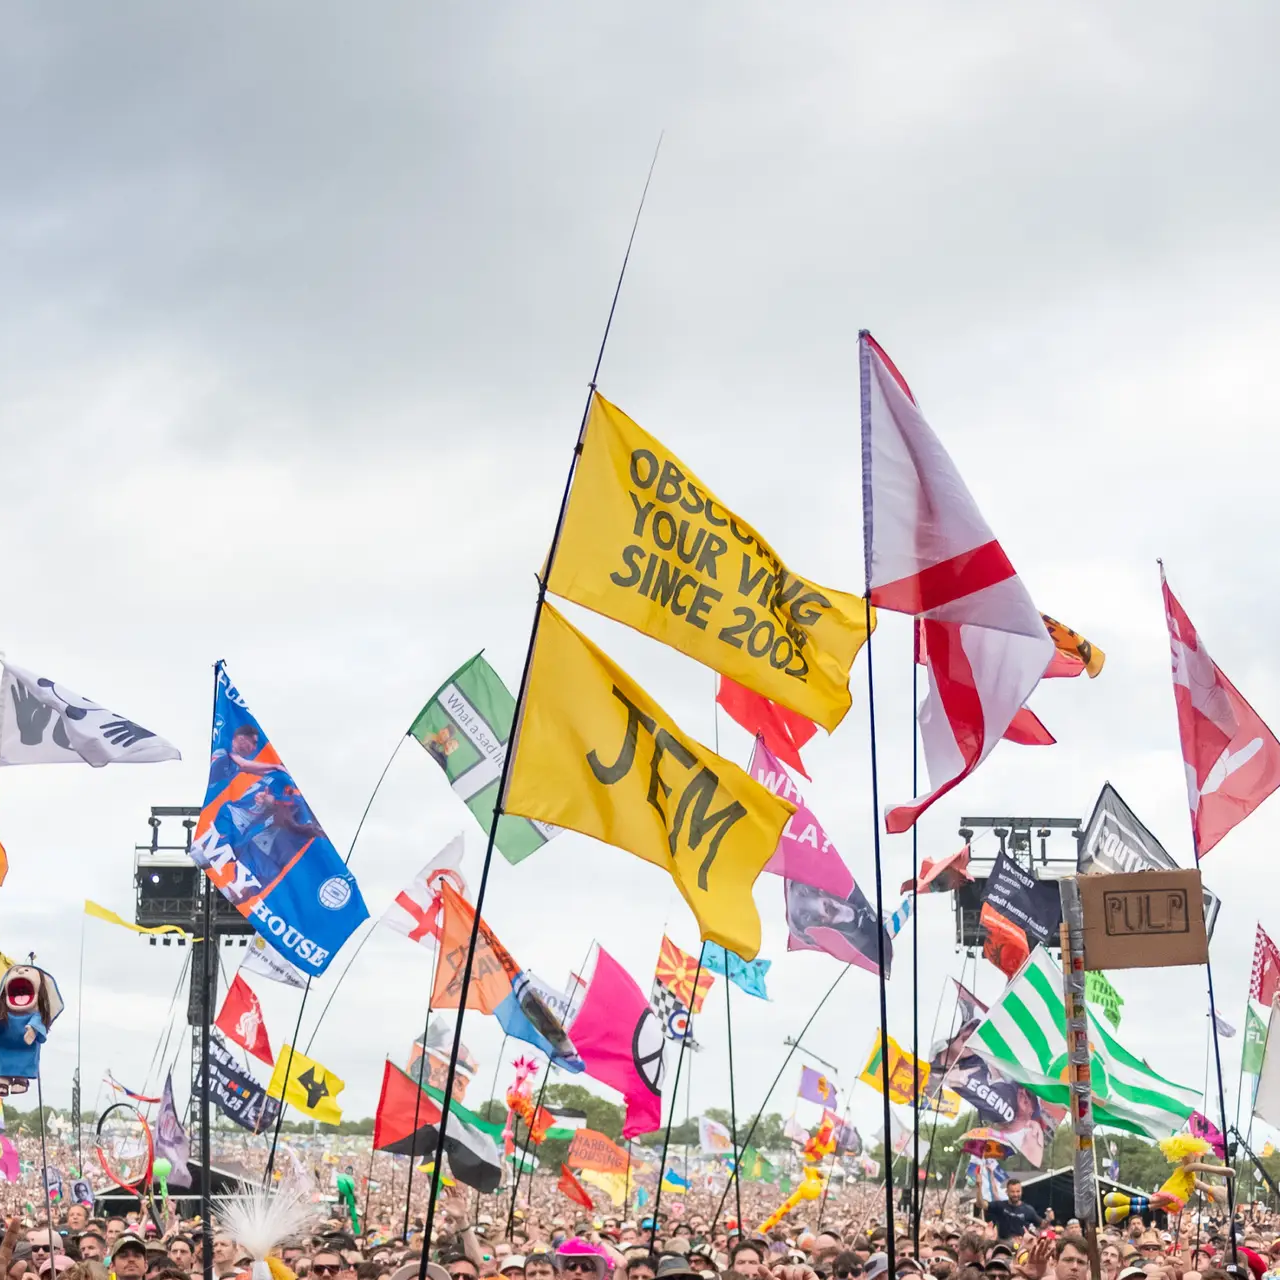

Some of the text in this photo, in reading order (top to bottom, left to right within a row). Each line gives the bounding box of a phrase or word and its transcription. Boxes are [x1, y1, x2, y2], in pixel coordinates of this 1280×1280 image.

[629, 491, 728, 580] YOUR
[609, 545, 810, 684] SINCE 2002
[447, 693, 474, 726] What
[477, 731, 496, 756] sad
[191, 821, 262, 900] MY
[993, 883, 1012, 896] noun
[250, 897, 330, 969] HOUSE
[987, 892, 1007, 908] adult
[1026, 915, 1049, 936] female
[1107, 894, 1183, 932] PULP
